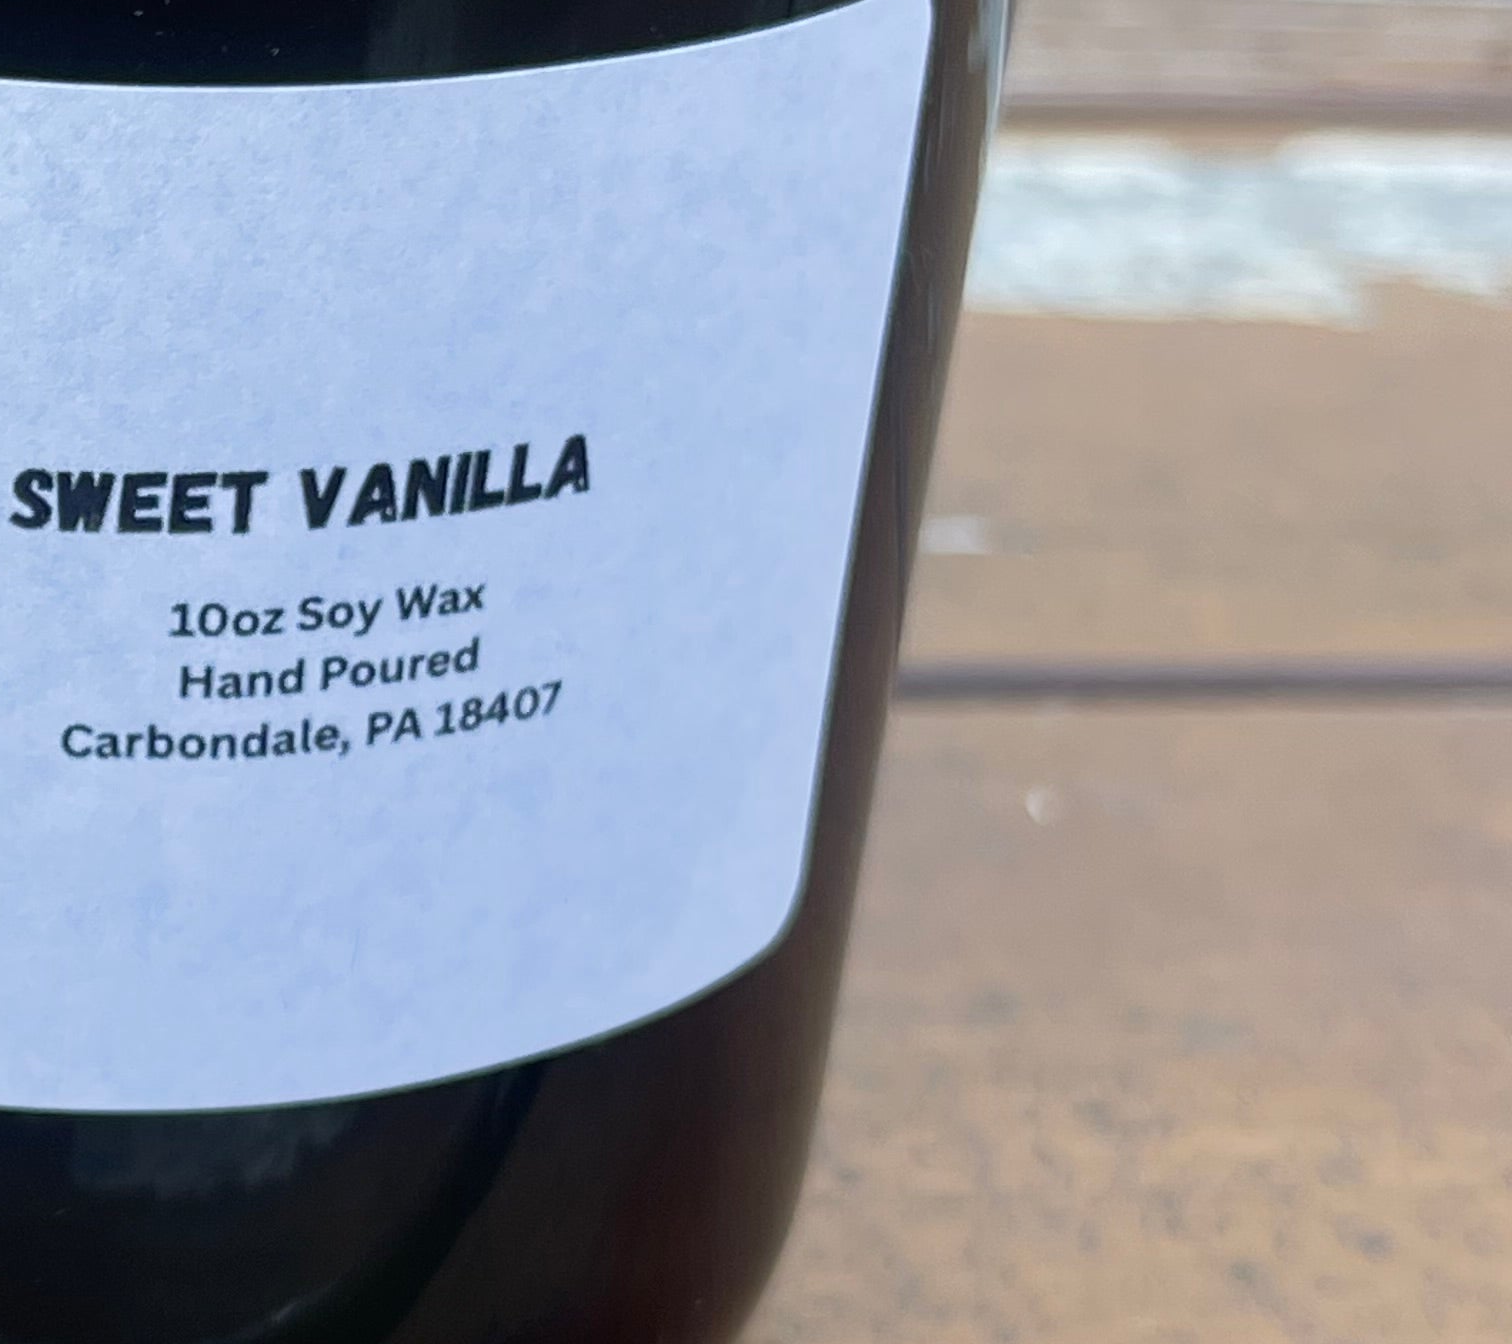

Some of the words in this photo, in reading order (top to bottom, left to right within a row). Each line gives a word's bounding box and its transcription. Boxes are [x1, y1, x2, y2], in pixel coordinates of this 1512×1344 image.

[9, 467, 269, 534] SWEET
[300, 433, 590, 530] VANILLA
[168, 601, 285, 638] 10oz
[297, 595, 383, 636] Soy
[396, 582, 485, 621] Wax
[178, 659, 304, 699] Hand
[320, 636, 481, 691] Poured
[60, 719, 351, 760] Carbondale,
[366, 707, 422, 746] PA
[434, 681, 563, 737] 18407
